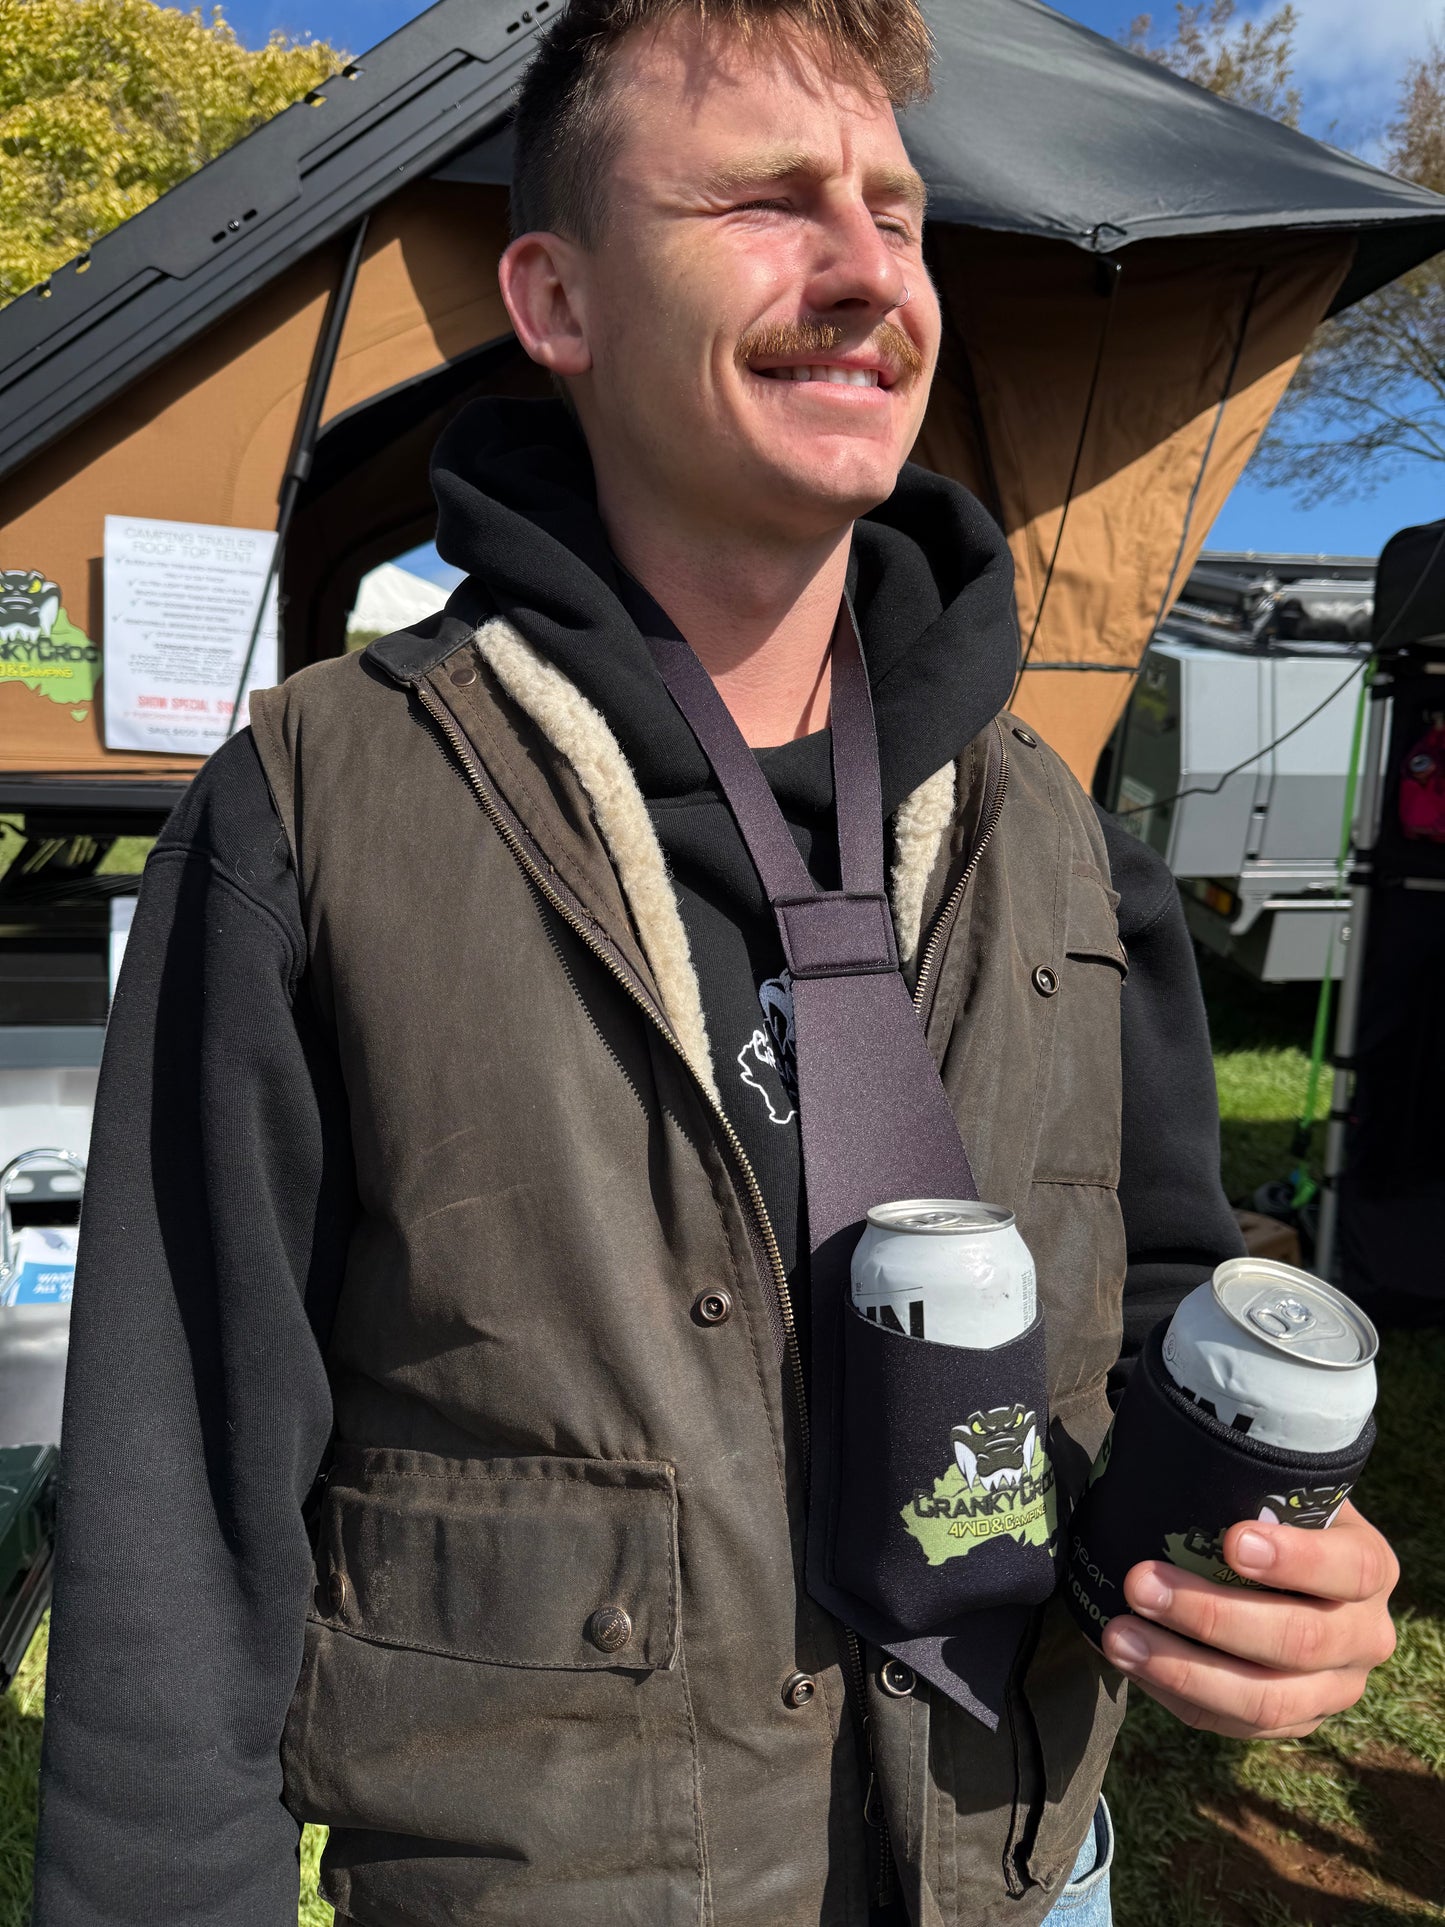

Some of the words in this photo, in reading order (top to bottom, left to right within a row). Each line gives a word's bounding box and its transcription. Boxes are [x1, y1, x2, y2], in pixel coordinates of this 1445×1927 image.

[125, 528, 195, 545] CAMPING
[181, 545, 211, 559] TOP
[1072, 1535, 1116, 1589] gear
